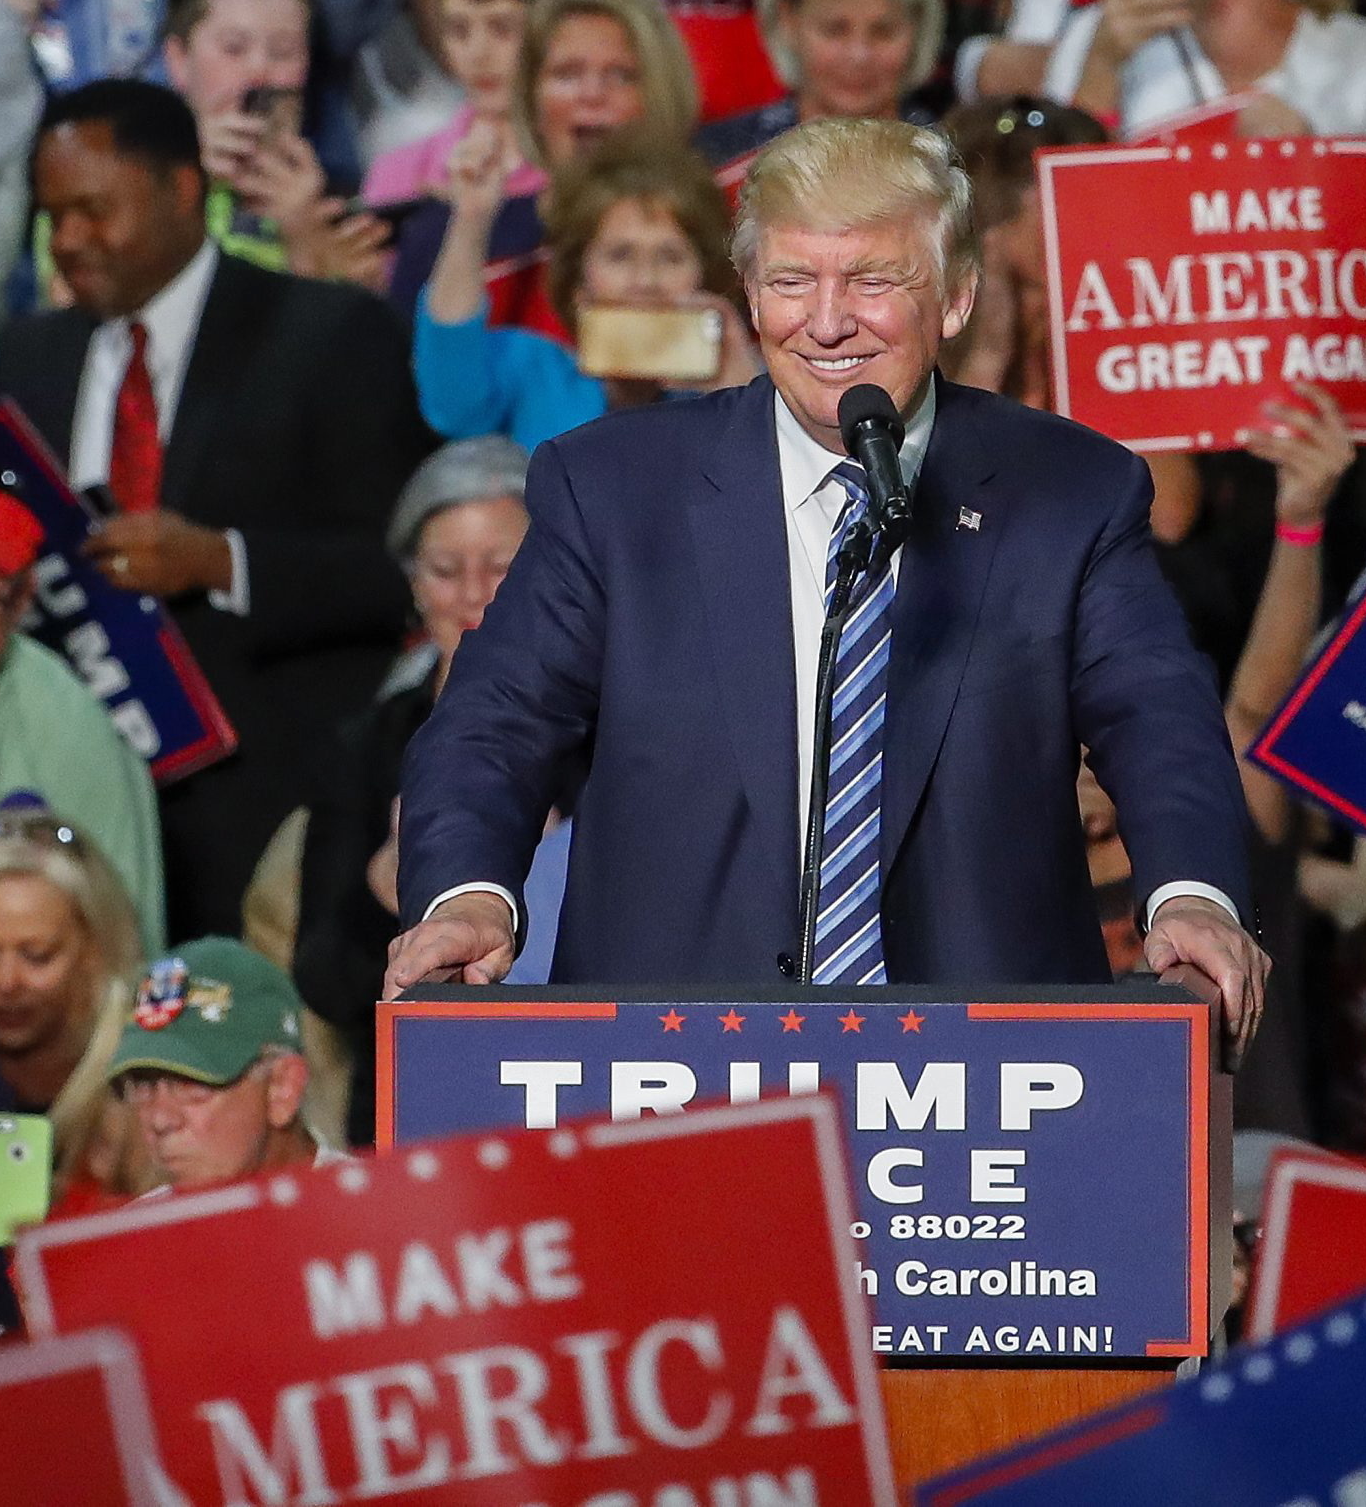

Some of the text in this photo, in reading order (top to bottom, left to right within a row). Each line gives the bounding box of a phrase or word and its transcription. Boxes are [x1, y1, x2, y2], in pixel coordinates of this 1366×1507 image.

[1189, 186, 1326, 235] MAKE
[1096, 336, 1270, 393] GREAT
[890, 1215, 1026, 1240] 88022
[304, 1221, 582, 1341] MAKE
[895, 1260, 1097, 1296] Carolina
[872, 1326, 1113, 1352] EAT AGAIN!
[197, 1304, 857, 1507] MERICA
